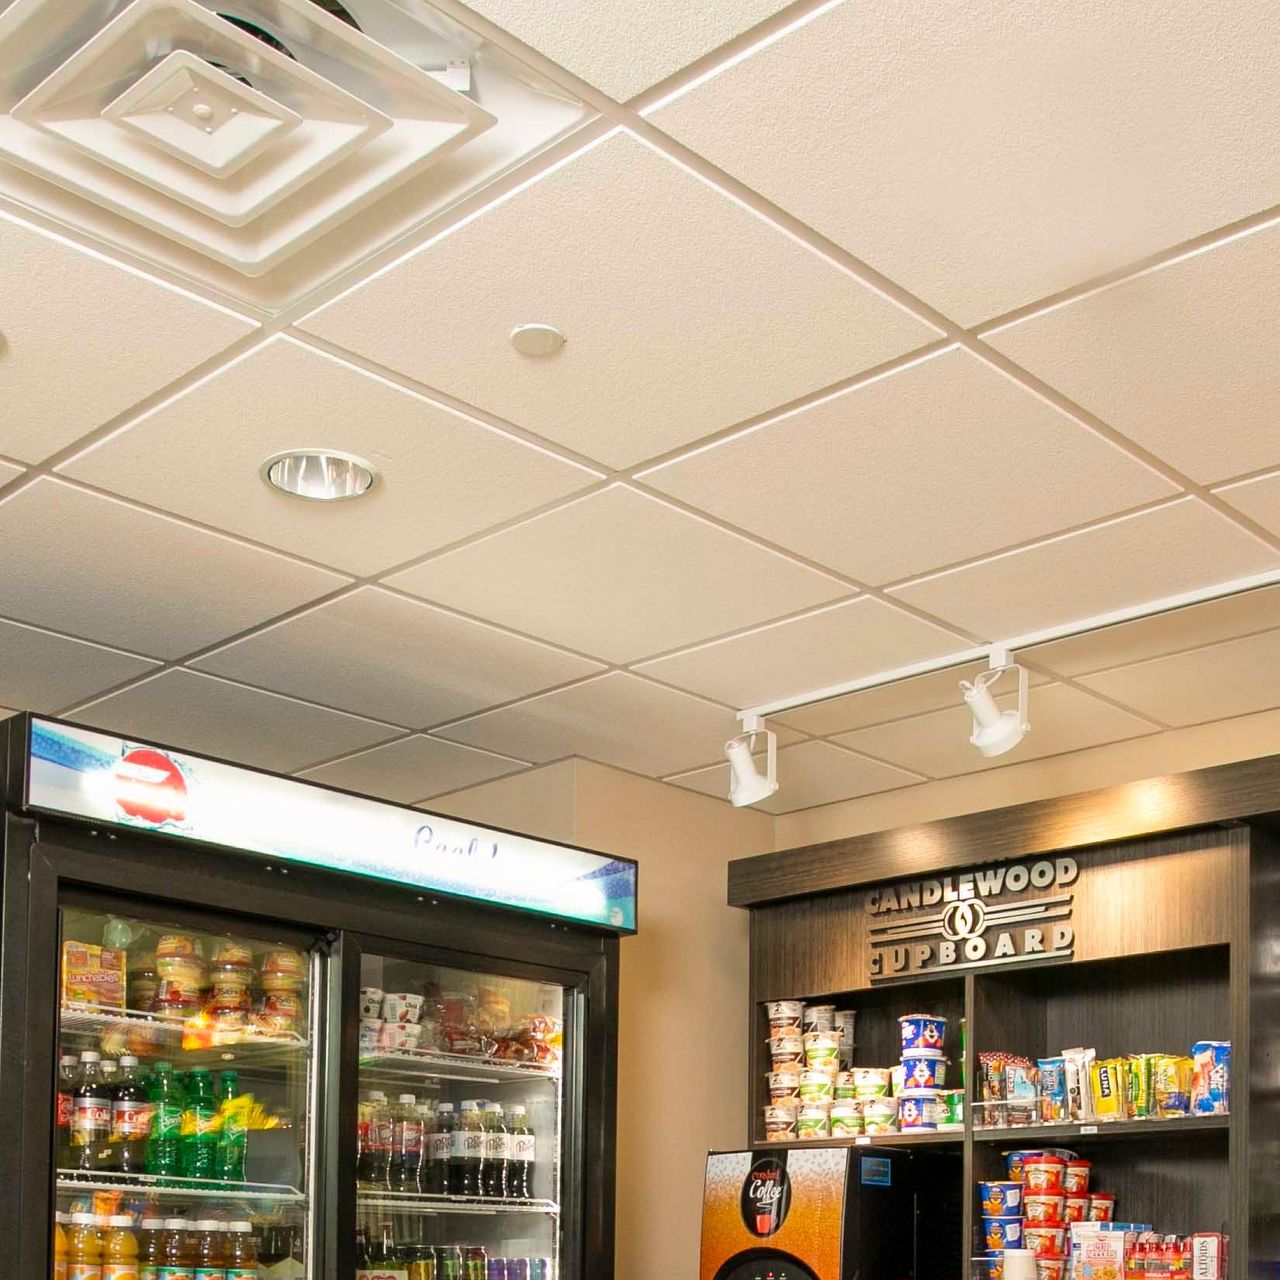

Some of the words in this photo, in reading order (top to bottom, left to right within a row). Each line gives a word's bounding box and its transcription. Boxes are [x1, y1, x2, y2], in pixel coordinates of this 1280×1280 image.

[868, 857, 1079, 916] CANDLEWOOD
[870, 926, 1073, 975] CUPBOARD
[1101, 1067, 1111, 1096] LUNA
[749, 1179, 782, 1203] Coffee
[1200, 1239, 1209, 1277] ALTOIDS
